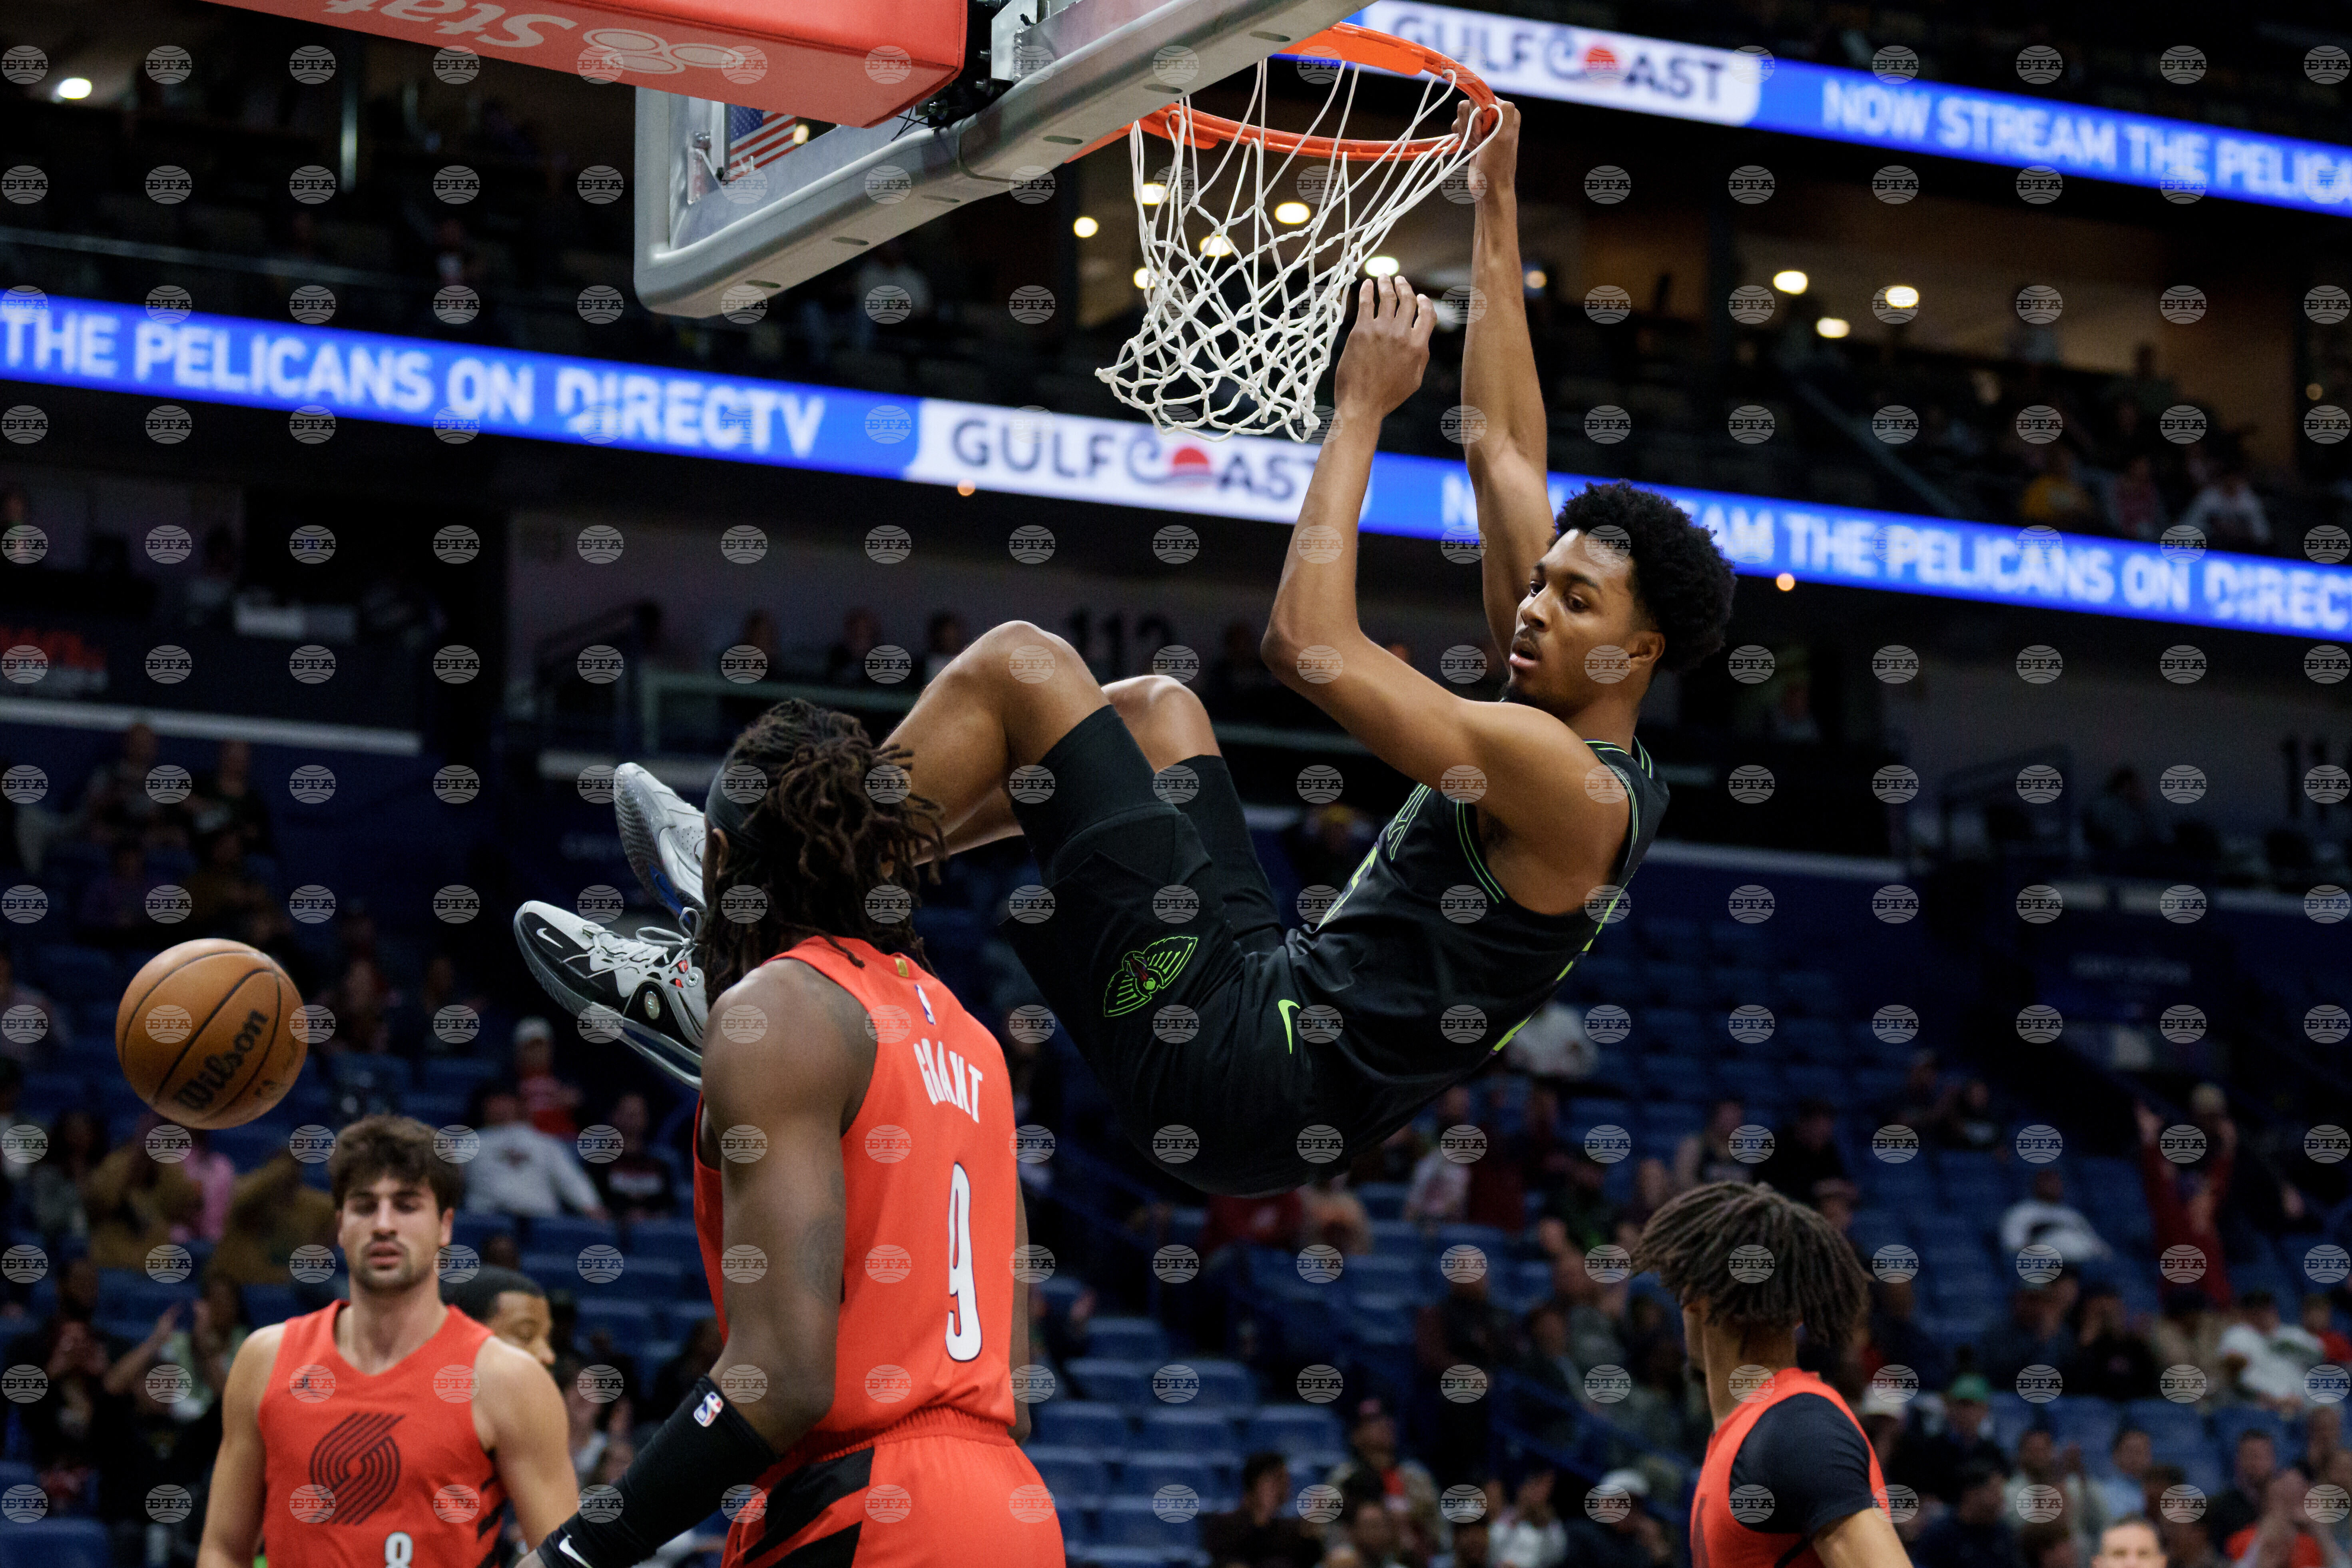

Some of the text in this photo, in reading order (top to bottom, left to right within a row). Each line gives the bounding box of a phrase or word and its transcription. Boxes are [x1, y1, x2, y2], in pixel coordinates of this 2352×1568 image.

[1823, 80, 1930, 141] NOW
[1937, 96, 2118, 171] STREAM
[2124, 123, 2208, 183] THE
[0, 308, 825, 459] THE PELICANS ON DIRECTV
[1781, 511, 1878, 578] THE
[1884, 525, 2115, 604] PELICANS
[2121, 554, 2190, 611] ON
[174, 1010, 269, 1111] Wilson
[913, 1038, 983, 1124] GRANT
[945, 1161, 983, 1363] 9
